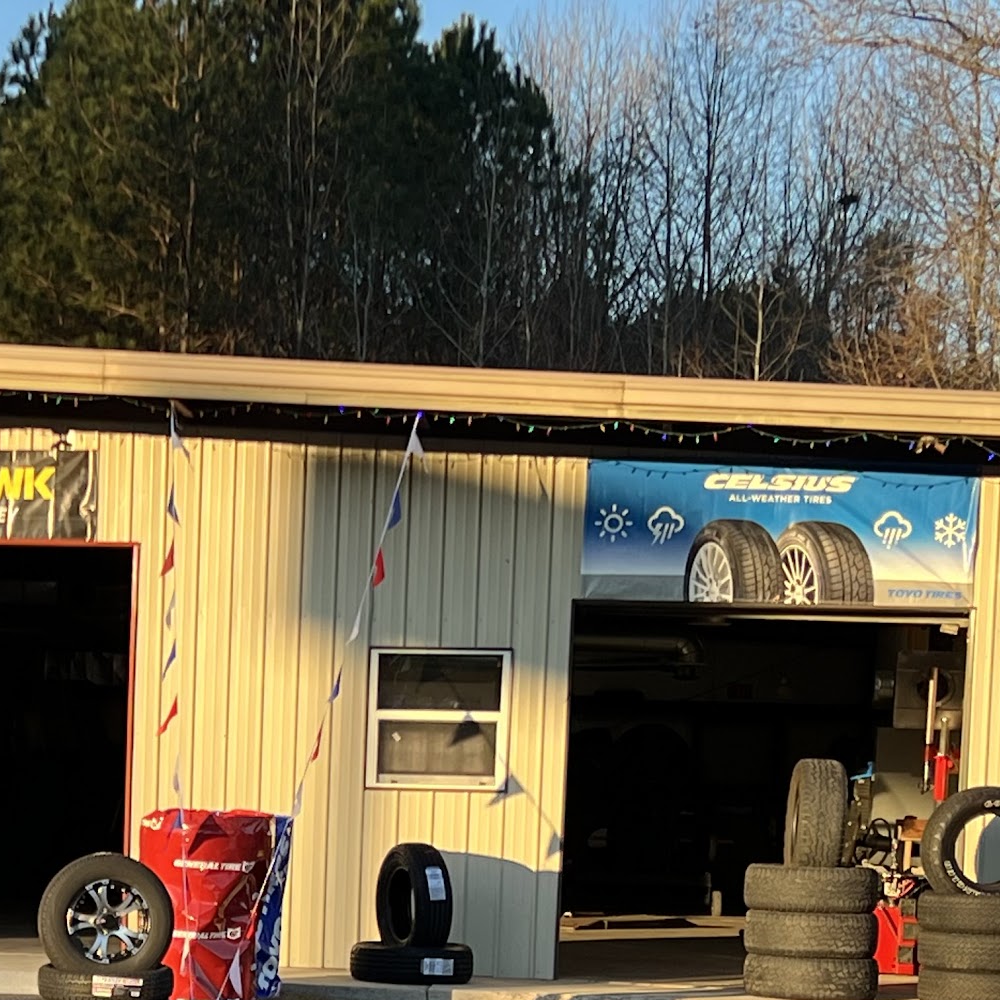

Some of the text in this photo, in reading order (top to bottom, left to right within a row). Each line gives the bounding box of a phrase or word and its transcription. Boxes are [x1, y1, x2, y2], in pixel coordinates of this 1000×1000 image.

[704, 473, 859, 492] CELSIUS
[729, 494, 832, 505] ALL-WEATHER TIRES
[888, 589, 963, 599] TOYO TIRES
